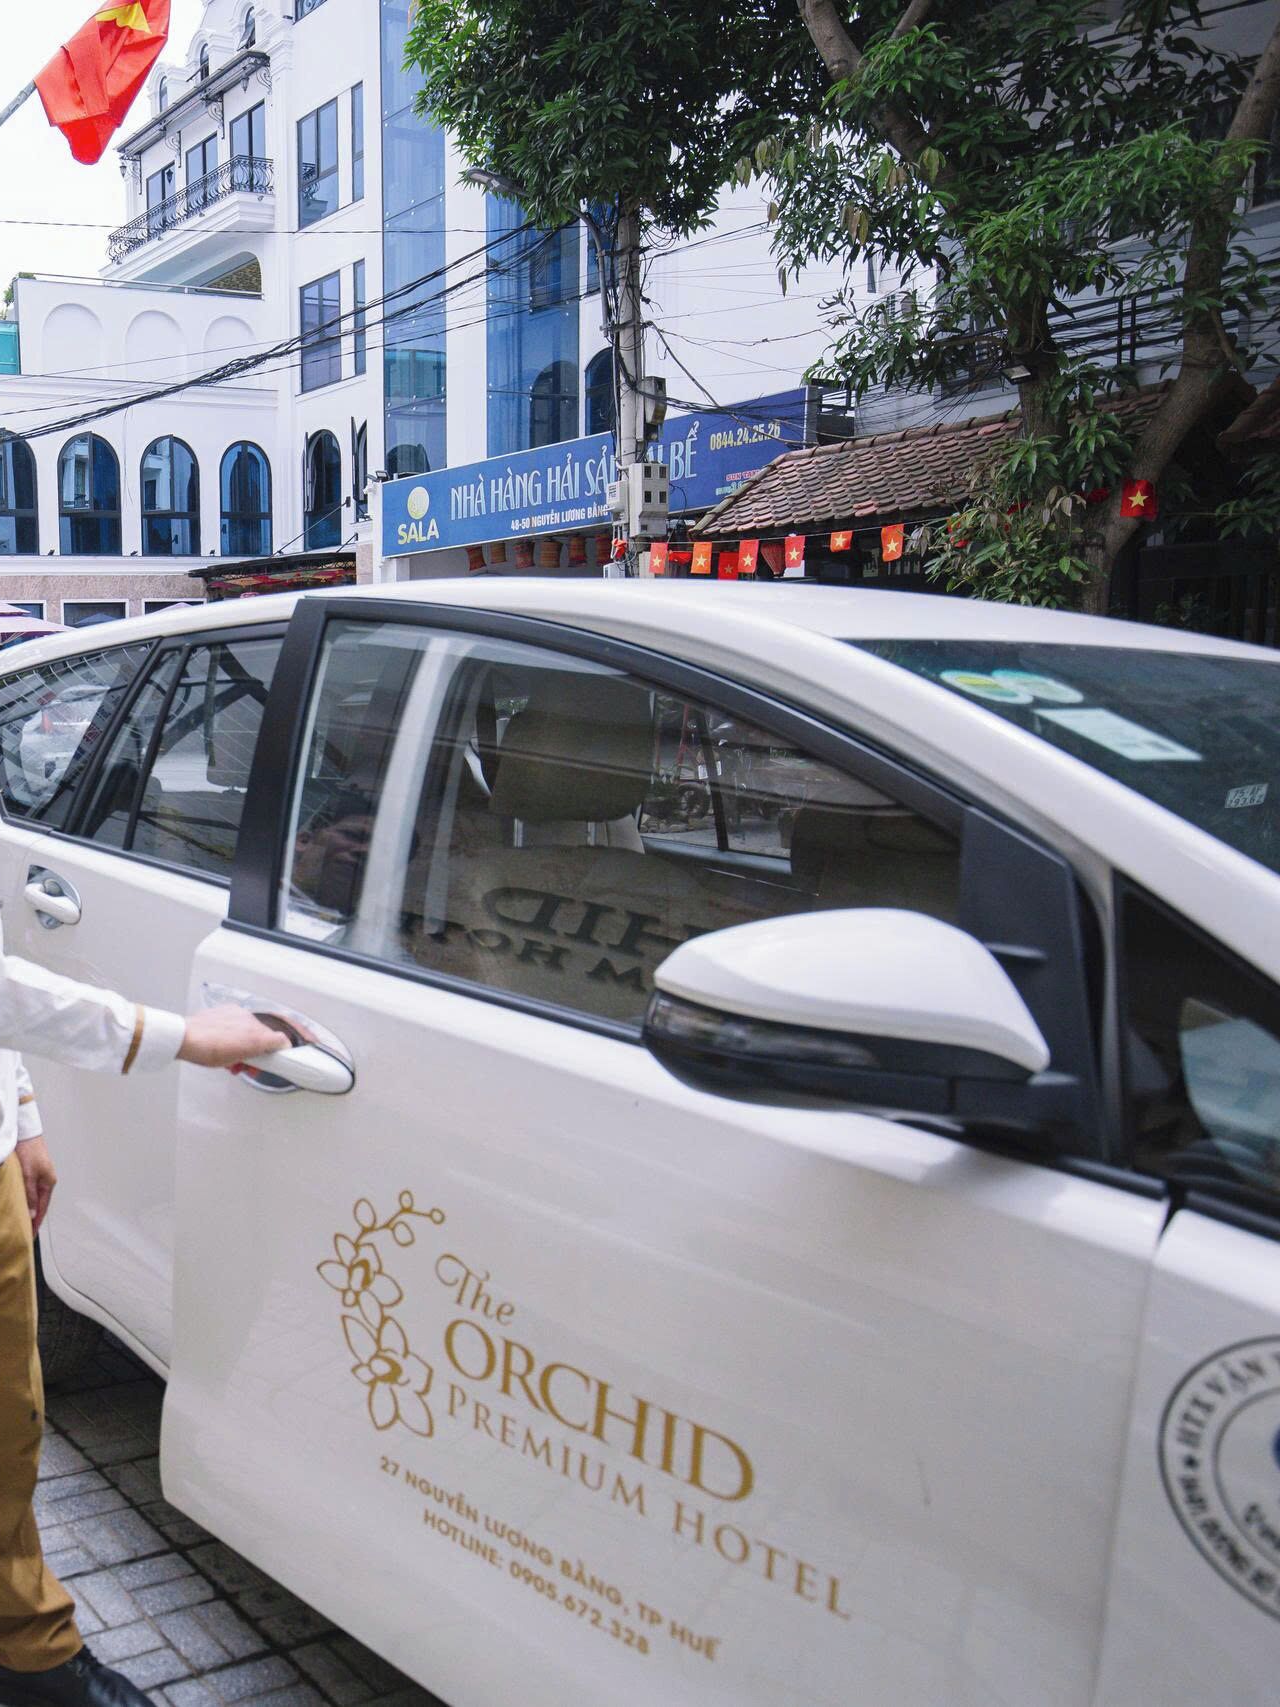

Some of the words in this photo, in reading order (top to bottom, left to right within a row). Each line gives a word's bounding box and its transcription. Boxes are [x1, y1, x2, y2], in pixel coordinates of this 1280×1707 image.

[450, 473, 487, 521] NHÀ
[490, 467, 542, 514] HÀNG
[547, 452, 580, 502] HẢI
[709, 420, 781, 451] 0844.24.25.26
[397, 518, 440, 545] SALA
[433, 1253, 517, 1326] The
[443, 1318, 756, 1503] ORCHID
[379, 1454, 400, 1477] 27
[637, 1601, 663, 1626] TP
[447, 1382, 648, 1518] PREMIUM
[671, 1500, 853, 1621] HOTEL
[422, 1508, 503, 1569] HOTLINE:
[509, 1559, 651, 1656] 0905.672.328
